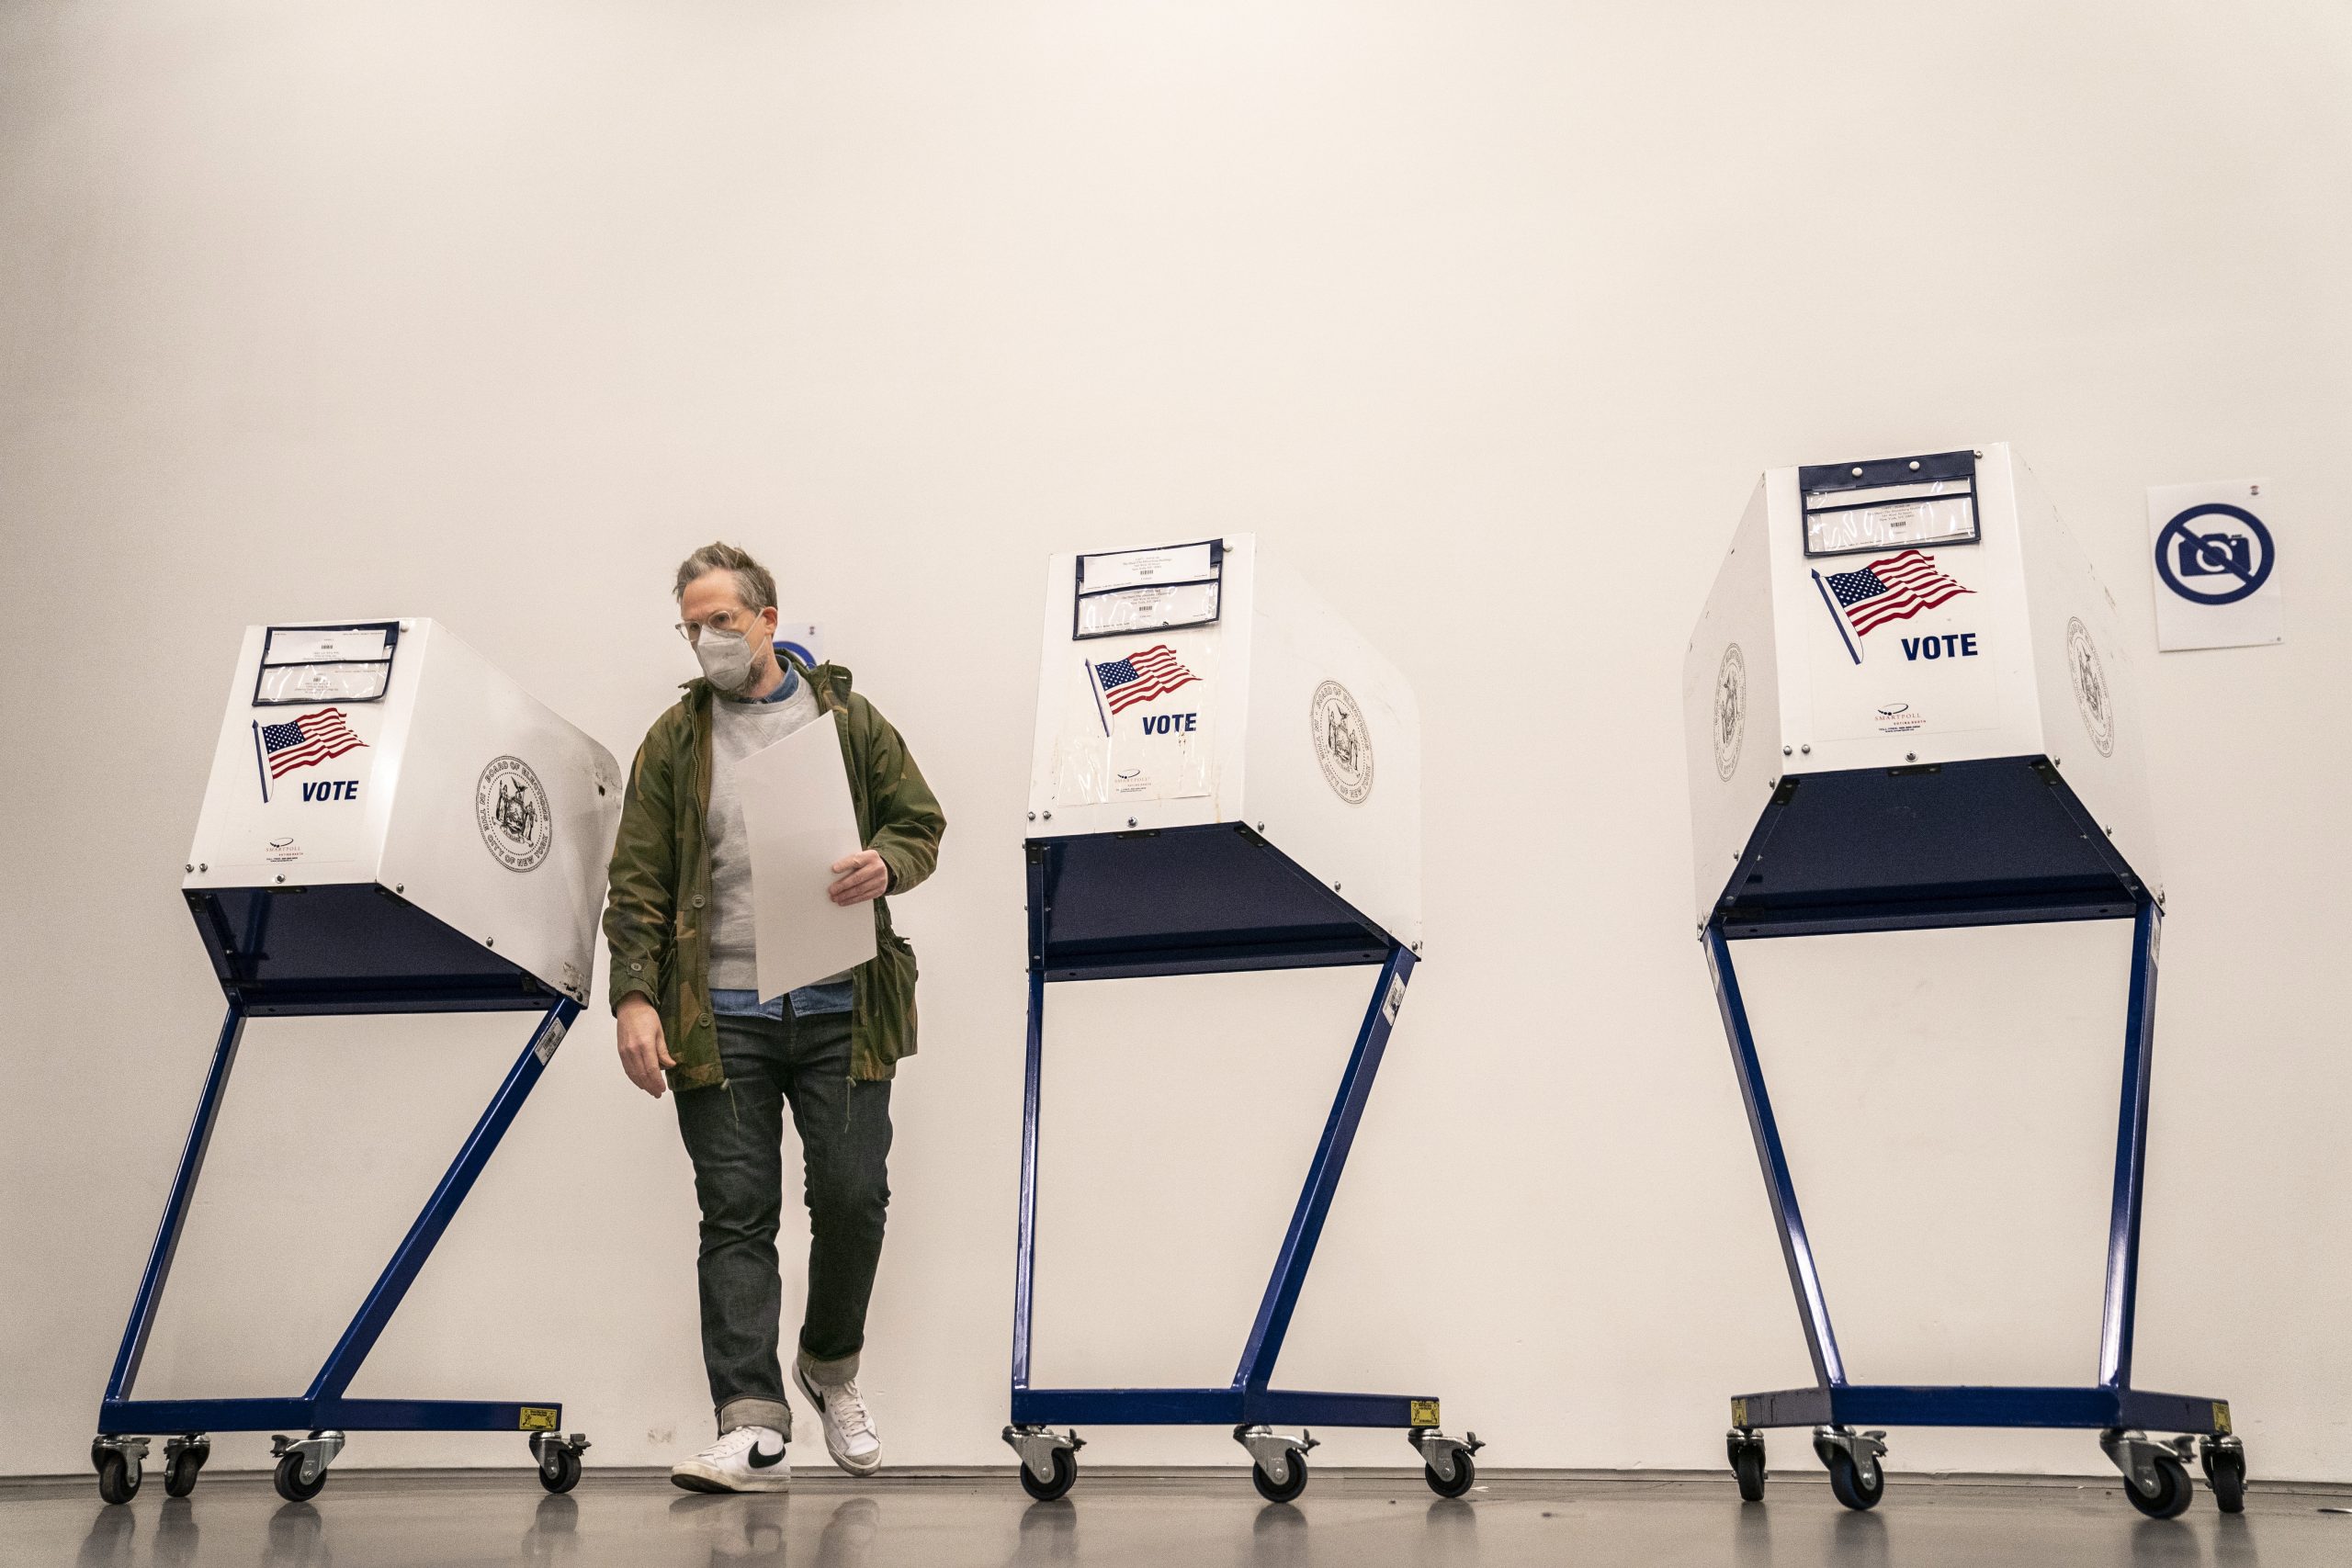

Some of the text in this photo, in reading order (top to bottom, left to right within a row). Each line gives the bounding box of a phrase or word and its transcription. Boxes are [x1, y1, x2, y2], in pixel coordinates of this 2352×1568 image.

[1901, 633, 1978, 661] VOTE
[1142, 713, 1197, 736] VOTE
[1874, 713, 1921, 721] SMARTPOLL
[485, 761, 509, 784] BOARD
[510, 761, 520, 771] OF
[302, 780, 359, 802] VOTE
[479, 792, 487, 806] IN
[504, 854, 515, 864] OF
[517, 856, 535, 867] NEW
[535, 833, 548, 859] YORK
